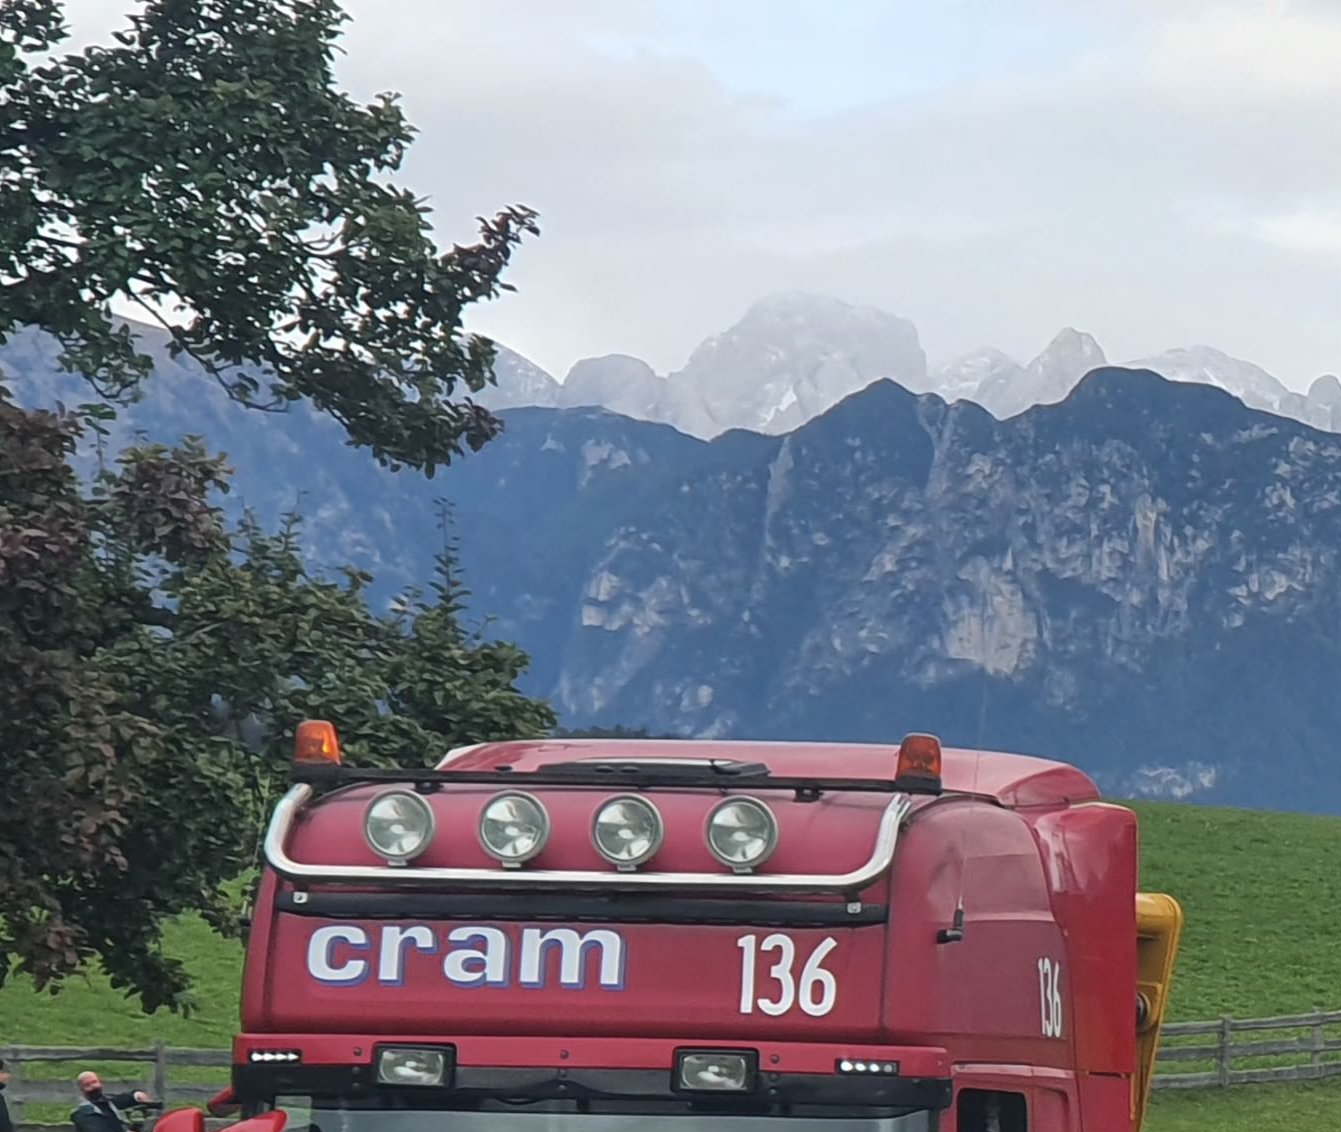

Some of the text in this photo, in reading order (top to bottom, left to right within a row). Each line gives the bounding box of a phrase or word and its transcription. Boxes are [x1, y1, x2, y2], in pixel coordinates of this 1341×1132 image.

[307, 925, 626, 990] cram
[737, 933, 838, 1017] 136
[1038, 957, 1062, 1037] 136
